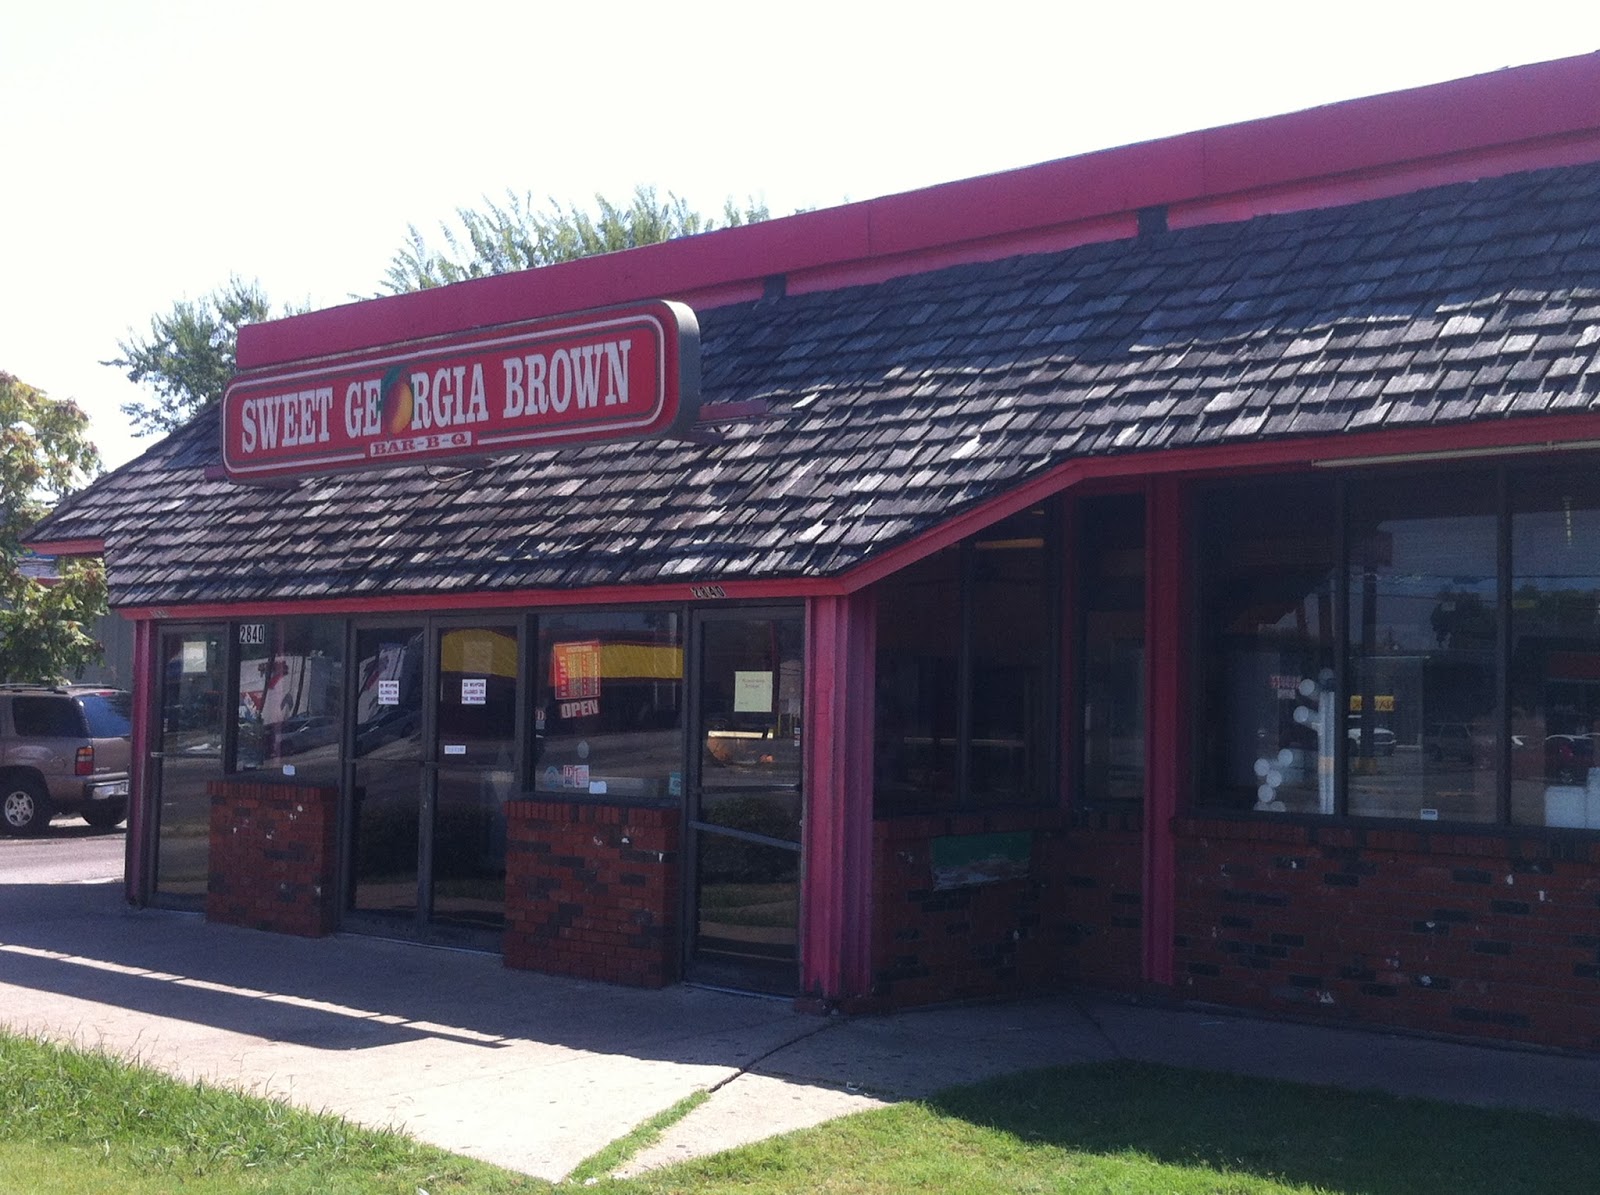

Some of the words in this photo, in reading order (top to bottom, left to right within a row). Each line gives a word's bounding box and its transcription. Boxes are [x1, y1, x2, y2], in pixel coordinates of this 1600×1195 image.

[241, 386, 333, 453] SWEET
[503, 340, 632, 418] BROWN
[373, 433, 468, 455] BAR-B-Q
[240, 624, 265, 644] 2840
[561, 699, 599, 718] OPEN
